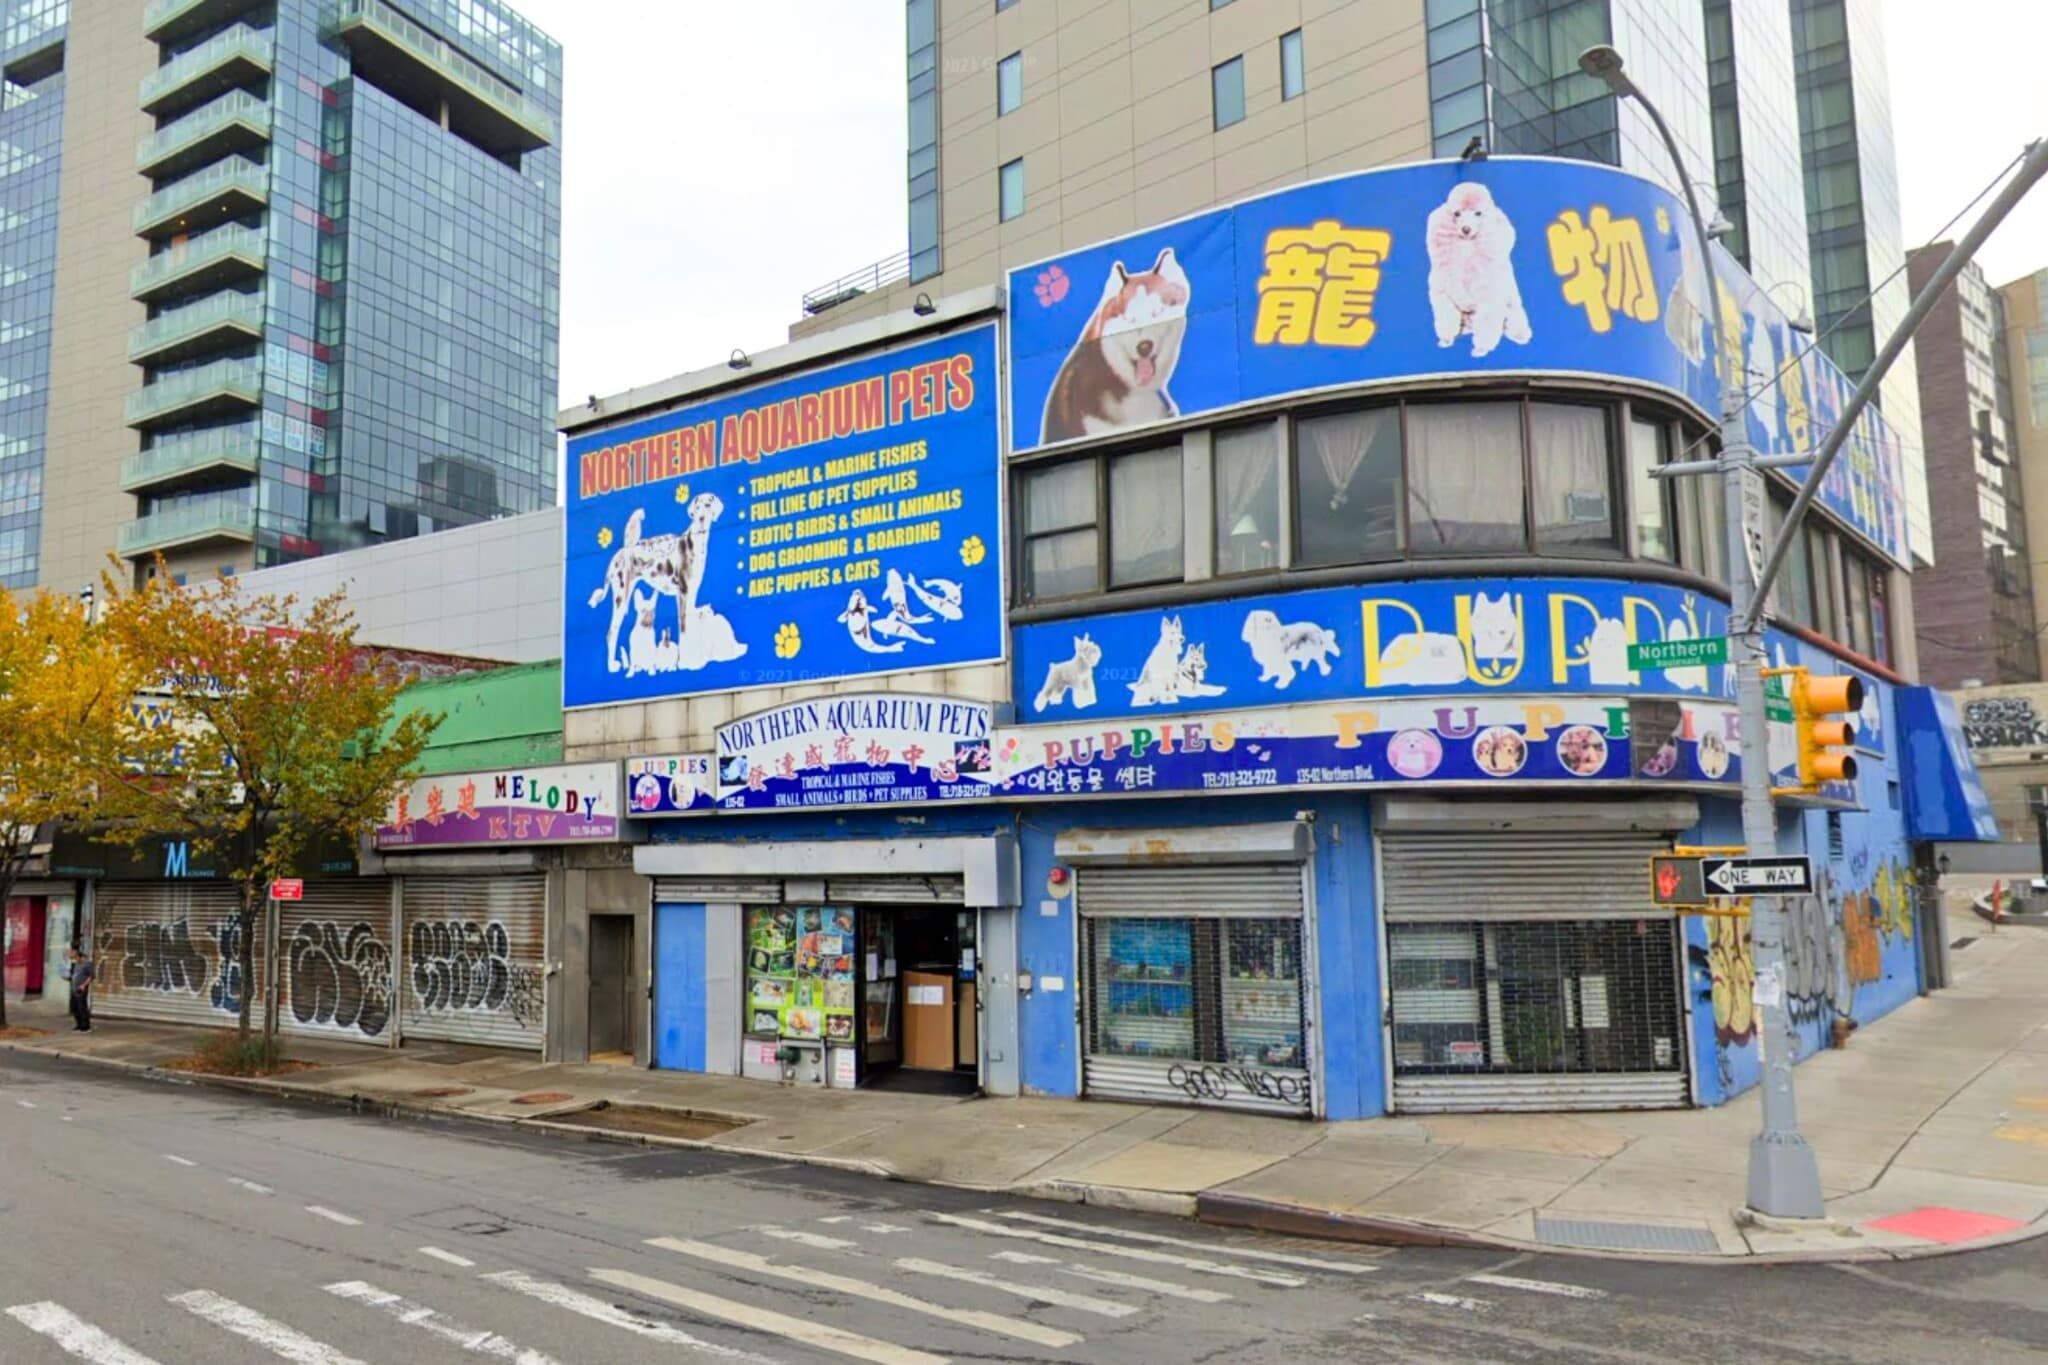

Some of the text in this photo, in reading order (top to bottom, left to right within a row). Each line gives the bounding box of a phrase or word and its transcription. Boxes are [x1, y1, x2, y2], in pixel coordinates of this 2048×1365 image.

[1545, 206, 1661, 334] 物
[580, 354, 975, 499] NORTHERN AQUARIUM PETS
[750, 440, 927, 497] TROPICAL & MARINE FISHES
[750, 471, 917, 521] FULL LINE OF PET SUPPLIES
[749, 489, 962, 547] EXOTIC BIRDS & SMALL ANIMALS
[749, 521, 940, 573] DOG GROOMING & BOARDING
[748, 559, 880, 597] AKC PUPPIES & CATS
[1639, 641, 1717, 659] Northern
[719, 700, 989, 754] NORTHERN AQUARIUM PETS
[1043, 719, 1237, 769] PUPPIES
[632, 759, 708, 775] PUPPIES
[801, 775, 833, 790] TROPICAL
[842, 773, 870, 788] MARINE
[871, 771, 896, 785] FISHES
[1297, 764, 1374, 784] 135-02 Northern Blvd.
[495, 775, 597, 823] MELODY
[776, 785, 927, 806] SMALL ANIMALS BIRDS PET SUPPLIES
[489, 814, 557, 839] KTV
[164, 841, 187, 877] M
[1719, 868, 1796, 885] ONE WAY
